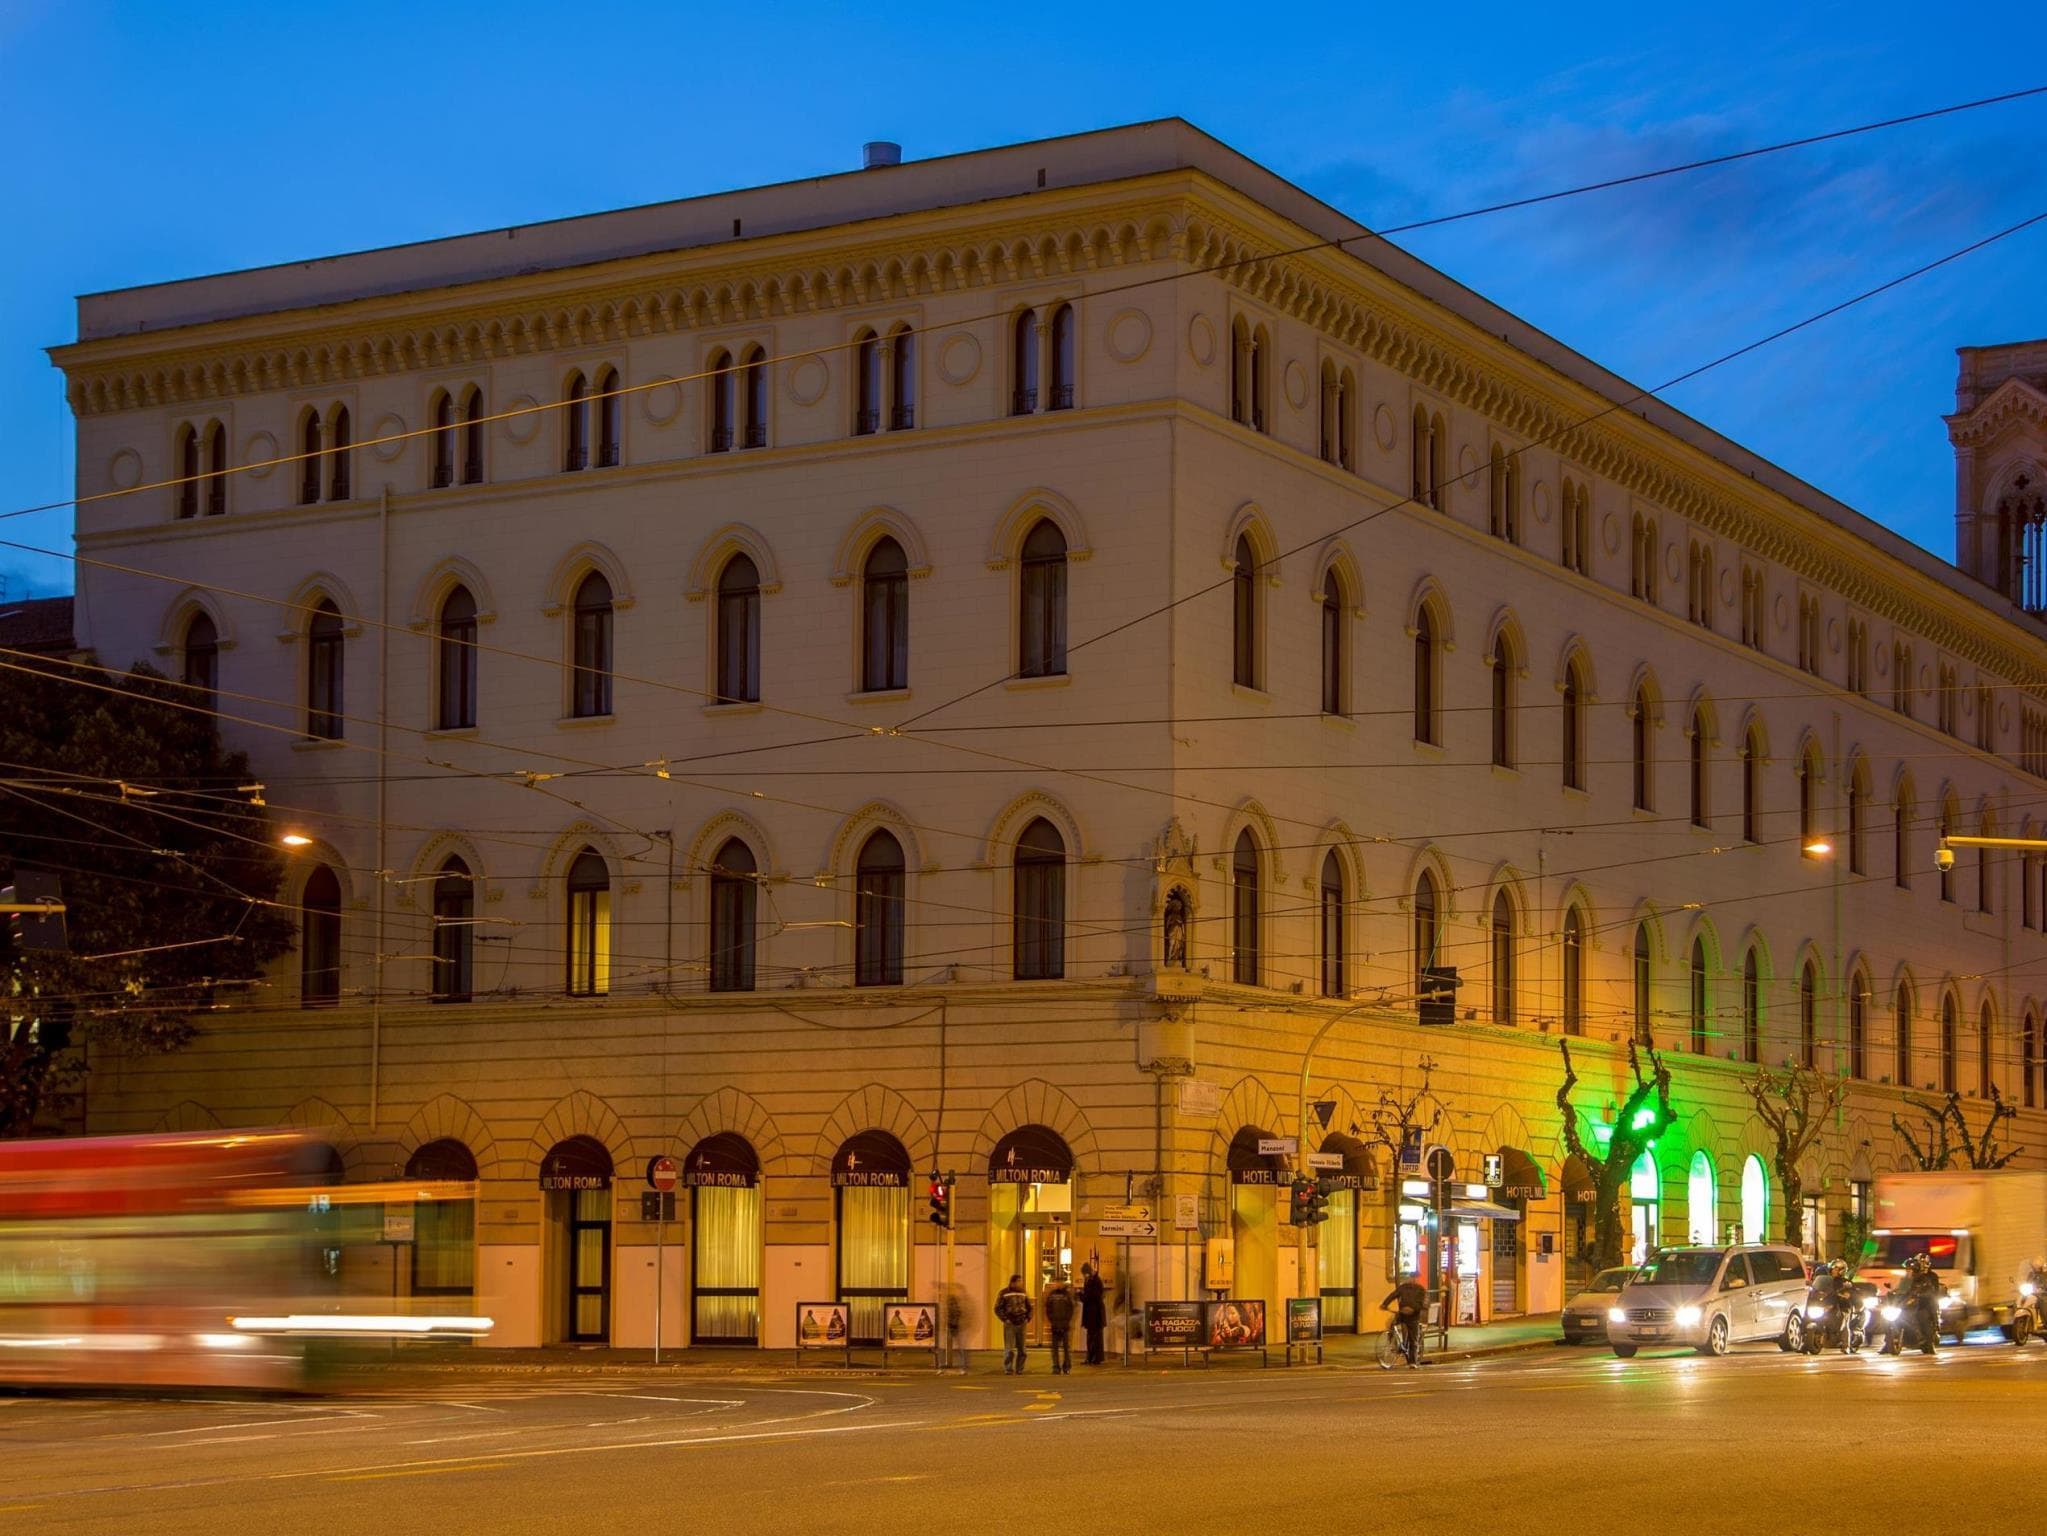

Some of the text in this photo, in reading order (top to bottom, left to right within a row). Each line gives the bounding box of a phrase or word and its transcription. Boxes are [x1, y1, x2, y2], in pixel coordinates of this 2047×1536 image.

[717, 1173, 747, 1186] ROMA
[870, 1173, 899, 1186] ROMA
[996, 1168, 1028, 1182] MILTON
[1031, 1169, 1060, 1183] ROMA
[1242, 1170, 1275, 1183] HOTEL
[574, 1176, 602, 1189] ROMA
[1506, 1186, 1533, 1198] HOTEL
[1101, 1224, 1125, 1232] termini
[1149, 1319, 1160, 1327] LA
[1166, 1325, 1196, 1333] FUOCO
